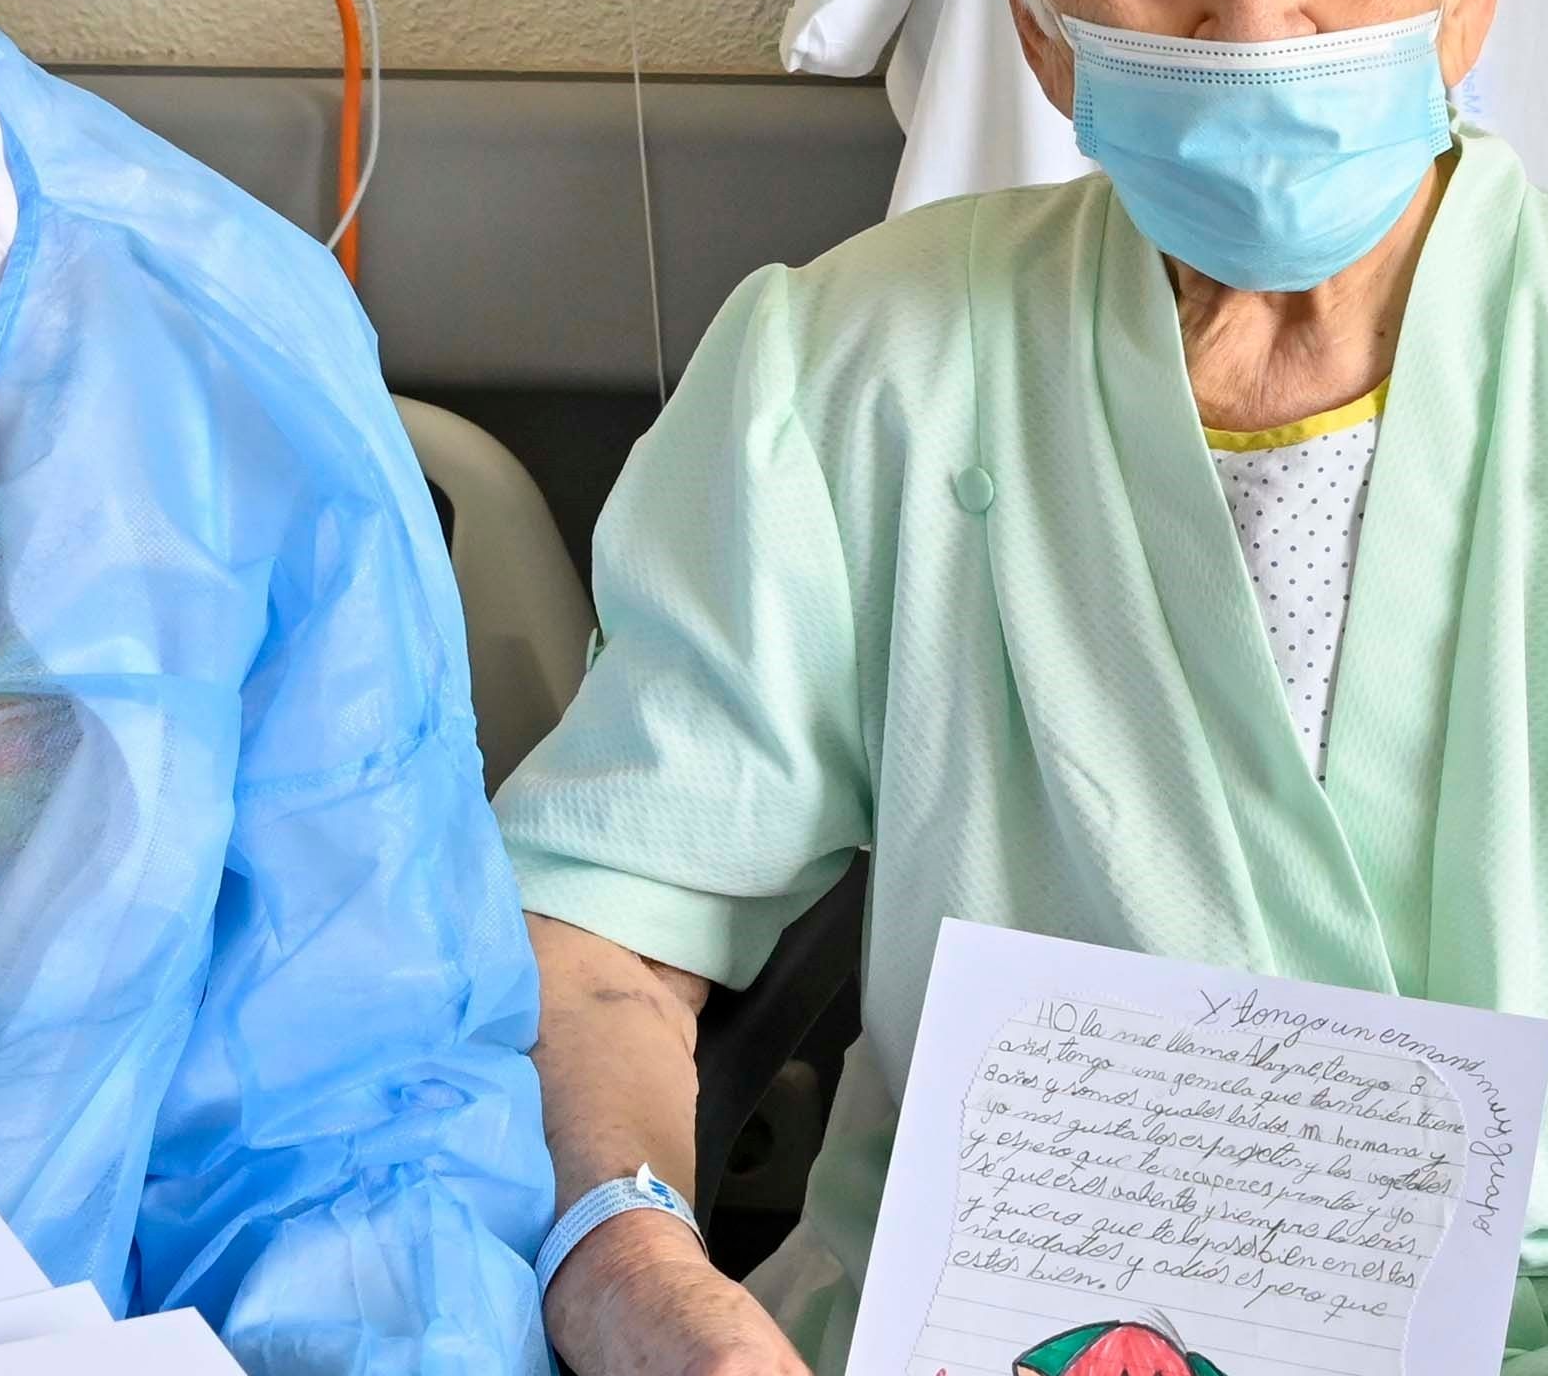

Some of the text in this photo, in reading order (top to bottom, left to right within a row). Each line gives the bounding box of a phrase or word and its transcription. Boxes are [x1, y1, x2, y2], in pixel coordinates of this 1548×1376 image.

[1112, 1028, 1162, 1049] me
[1409, 1075, 1427, 1095] 8
[1042, 1078, 1063, 1104] y
[961, 1129, 986, 1159] y
[958, 1195, 985, 1222] y
